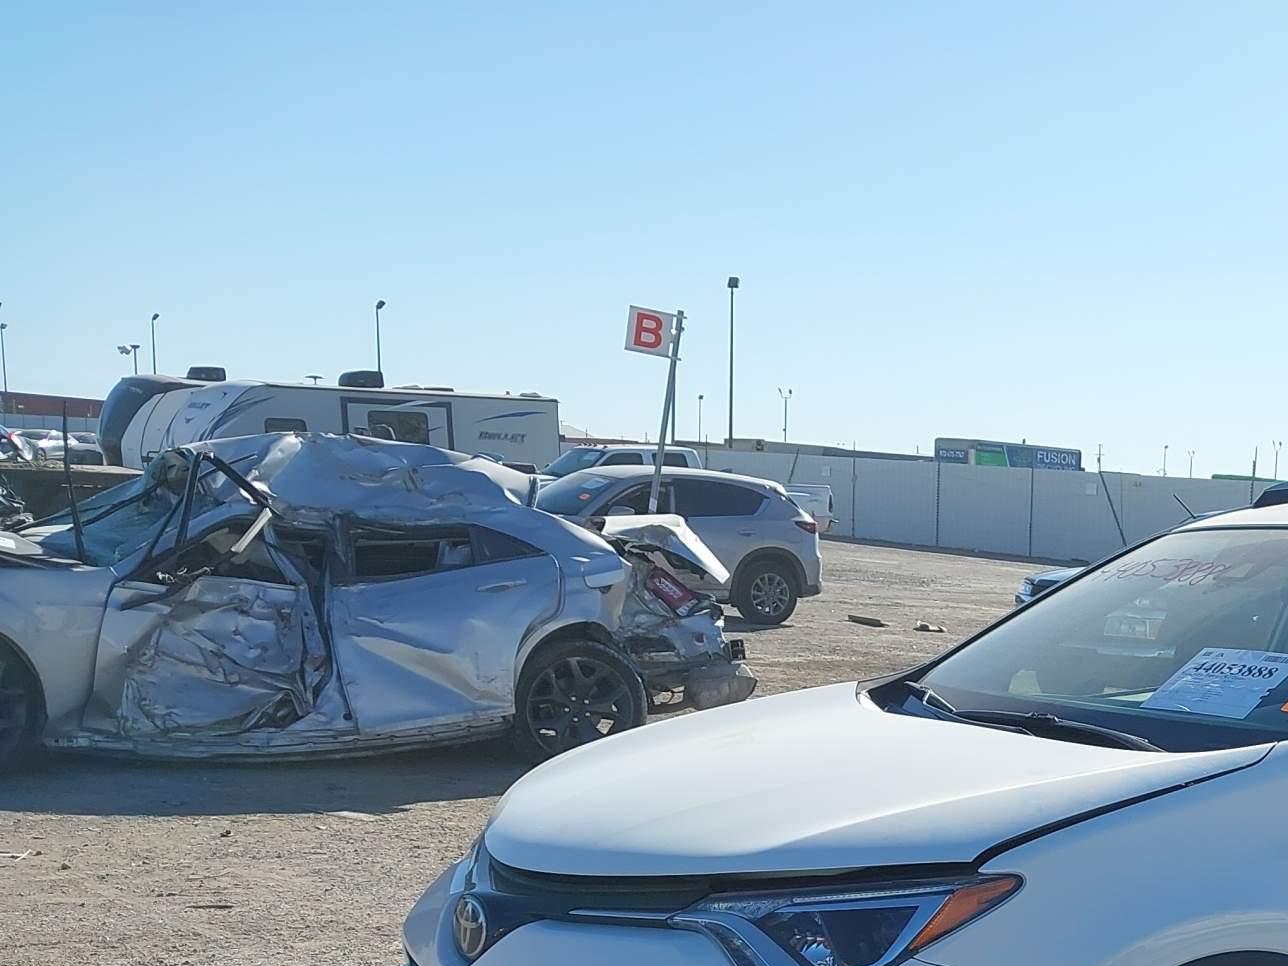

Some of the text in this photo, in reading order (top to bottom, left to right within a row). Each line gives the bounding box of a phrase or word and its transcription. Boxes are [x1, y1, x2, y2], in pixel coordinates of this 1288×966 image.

[633, 312, 663, 349] B
[1037, 450, 1077, 466] FUSION
[1193, 660, 1280, 680] 44053888
